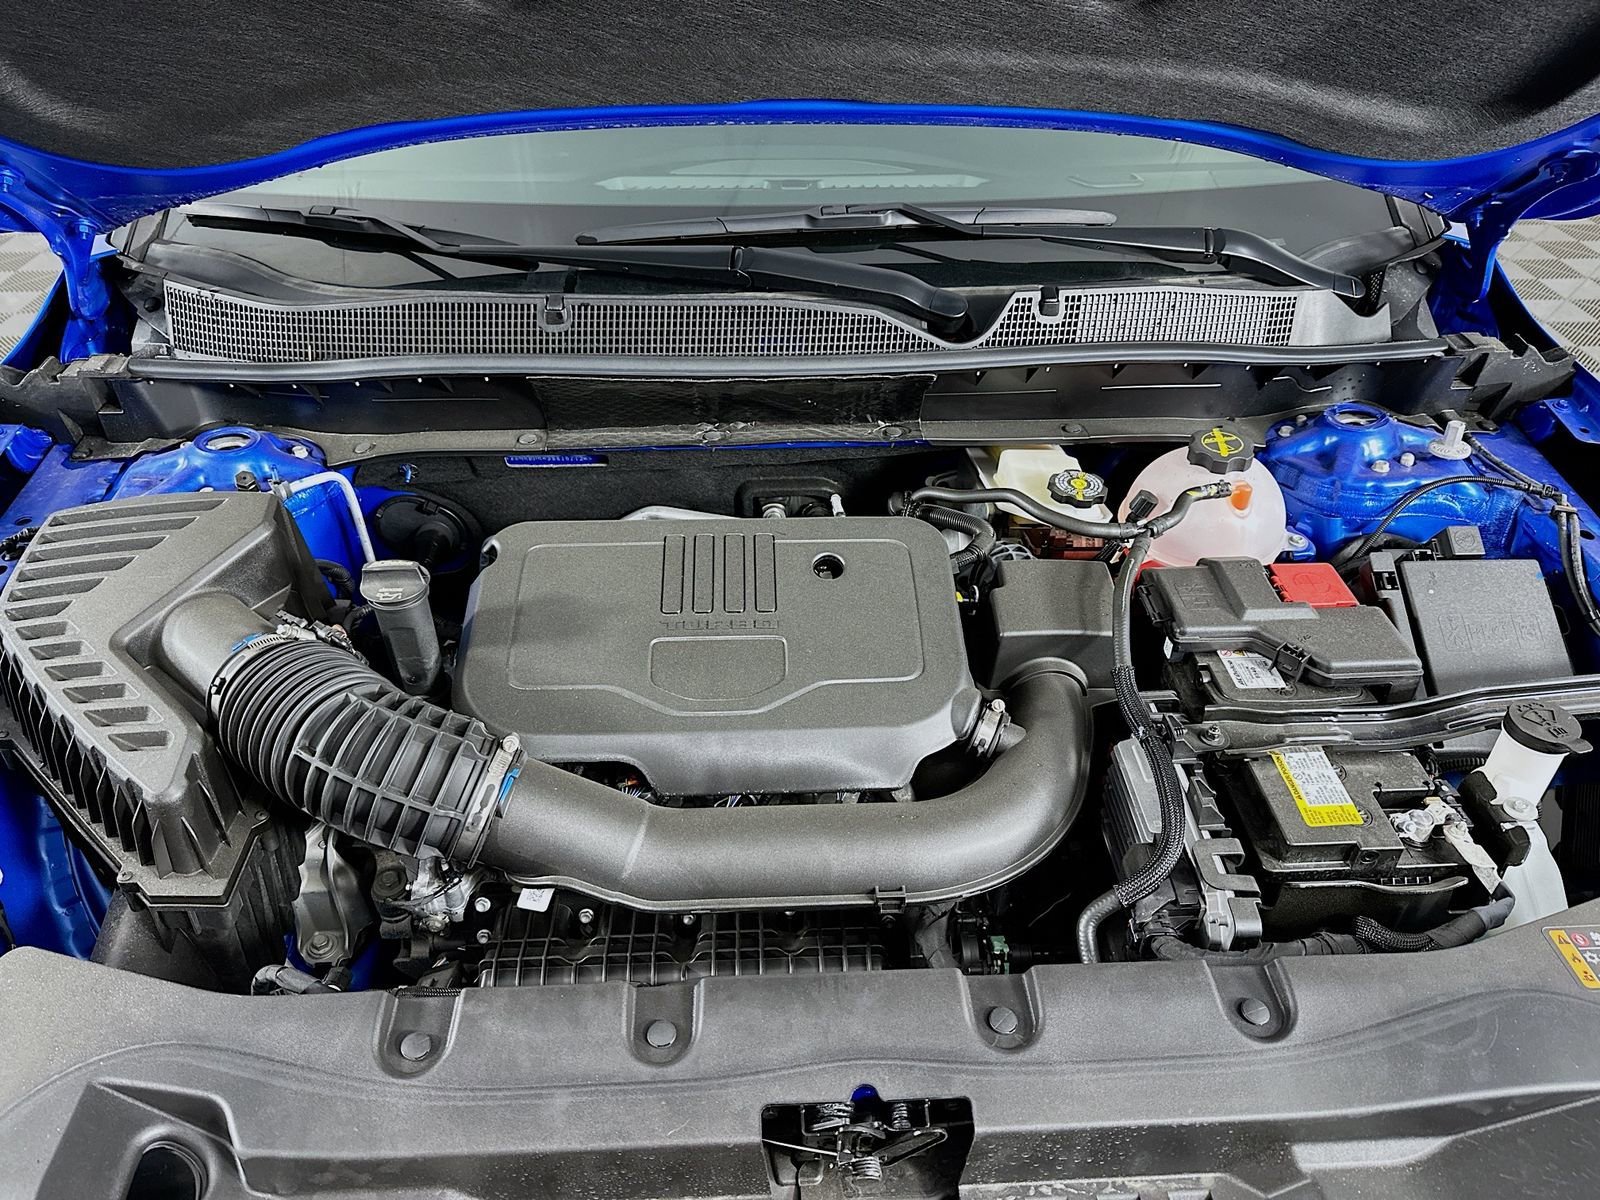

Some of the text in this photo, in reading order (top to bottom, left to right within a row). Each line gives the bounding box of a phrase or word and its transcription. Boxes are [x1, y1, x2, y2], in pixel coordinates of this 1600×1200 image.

[659, 619, 780, 631] TURBO
[1276, 756, 1300, 795] DANGER POISON
